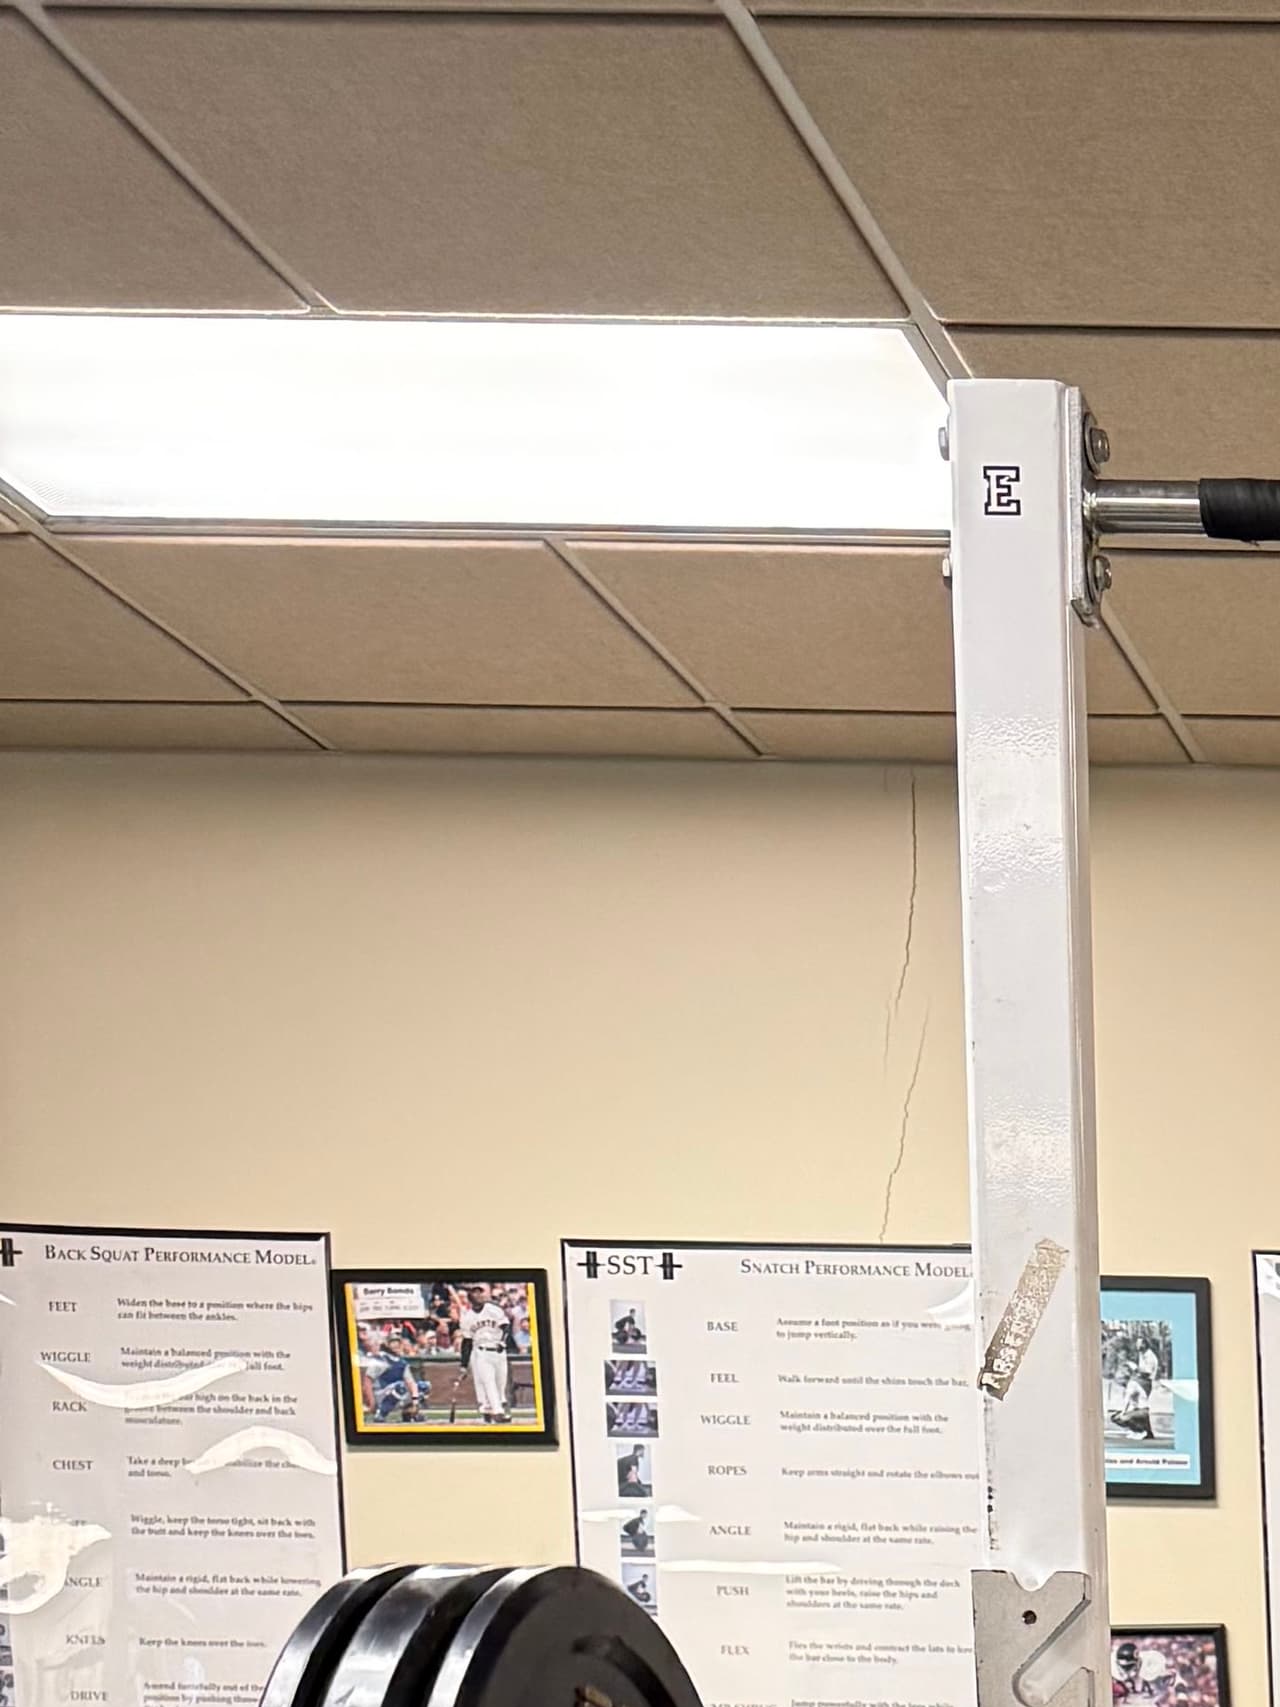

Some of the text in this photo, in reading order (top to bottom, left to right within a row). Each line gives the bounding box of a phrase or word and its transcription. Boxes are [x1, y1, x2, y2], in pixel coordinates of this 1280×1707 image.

[983, 466, 1021, 515] E
[45, 1244, 310, 1265] BACK SQUAT PERFORMANCE MODEL
[605, 1255, 655, 1275] SST
[741, 1258, 969, 1278] SNATCH PERFORMANCE MODEL
[49, 1301, 77, 1312] FEET
[707, 1321, 738, 1332] BASE
[40, 1352, 91, 1362] WIGGLE
[710, 1373, 739, 1383] FEEL
[52, 1400, 87, 1412] RACK
[700, 1414, 750, 1425] WIGGLE
[52, 1459, 93, 1470] CHEST
[708, 1465, 747, 1476] ROPES
[710, 1525, 750, 1535] ANGLE
[717, 1585, 749, 1596] PUSH
[721, 1645, 749, 1655] FLEX
